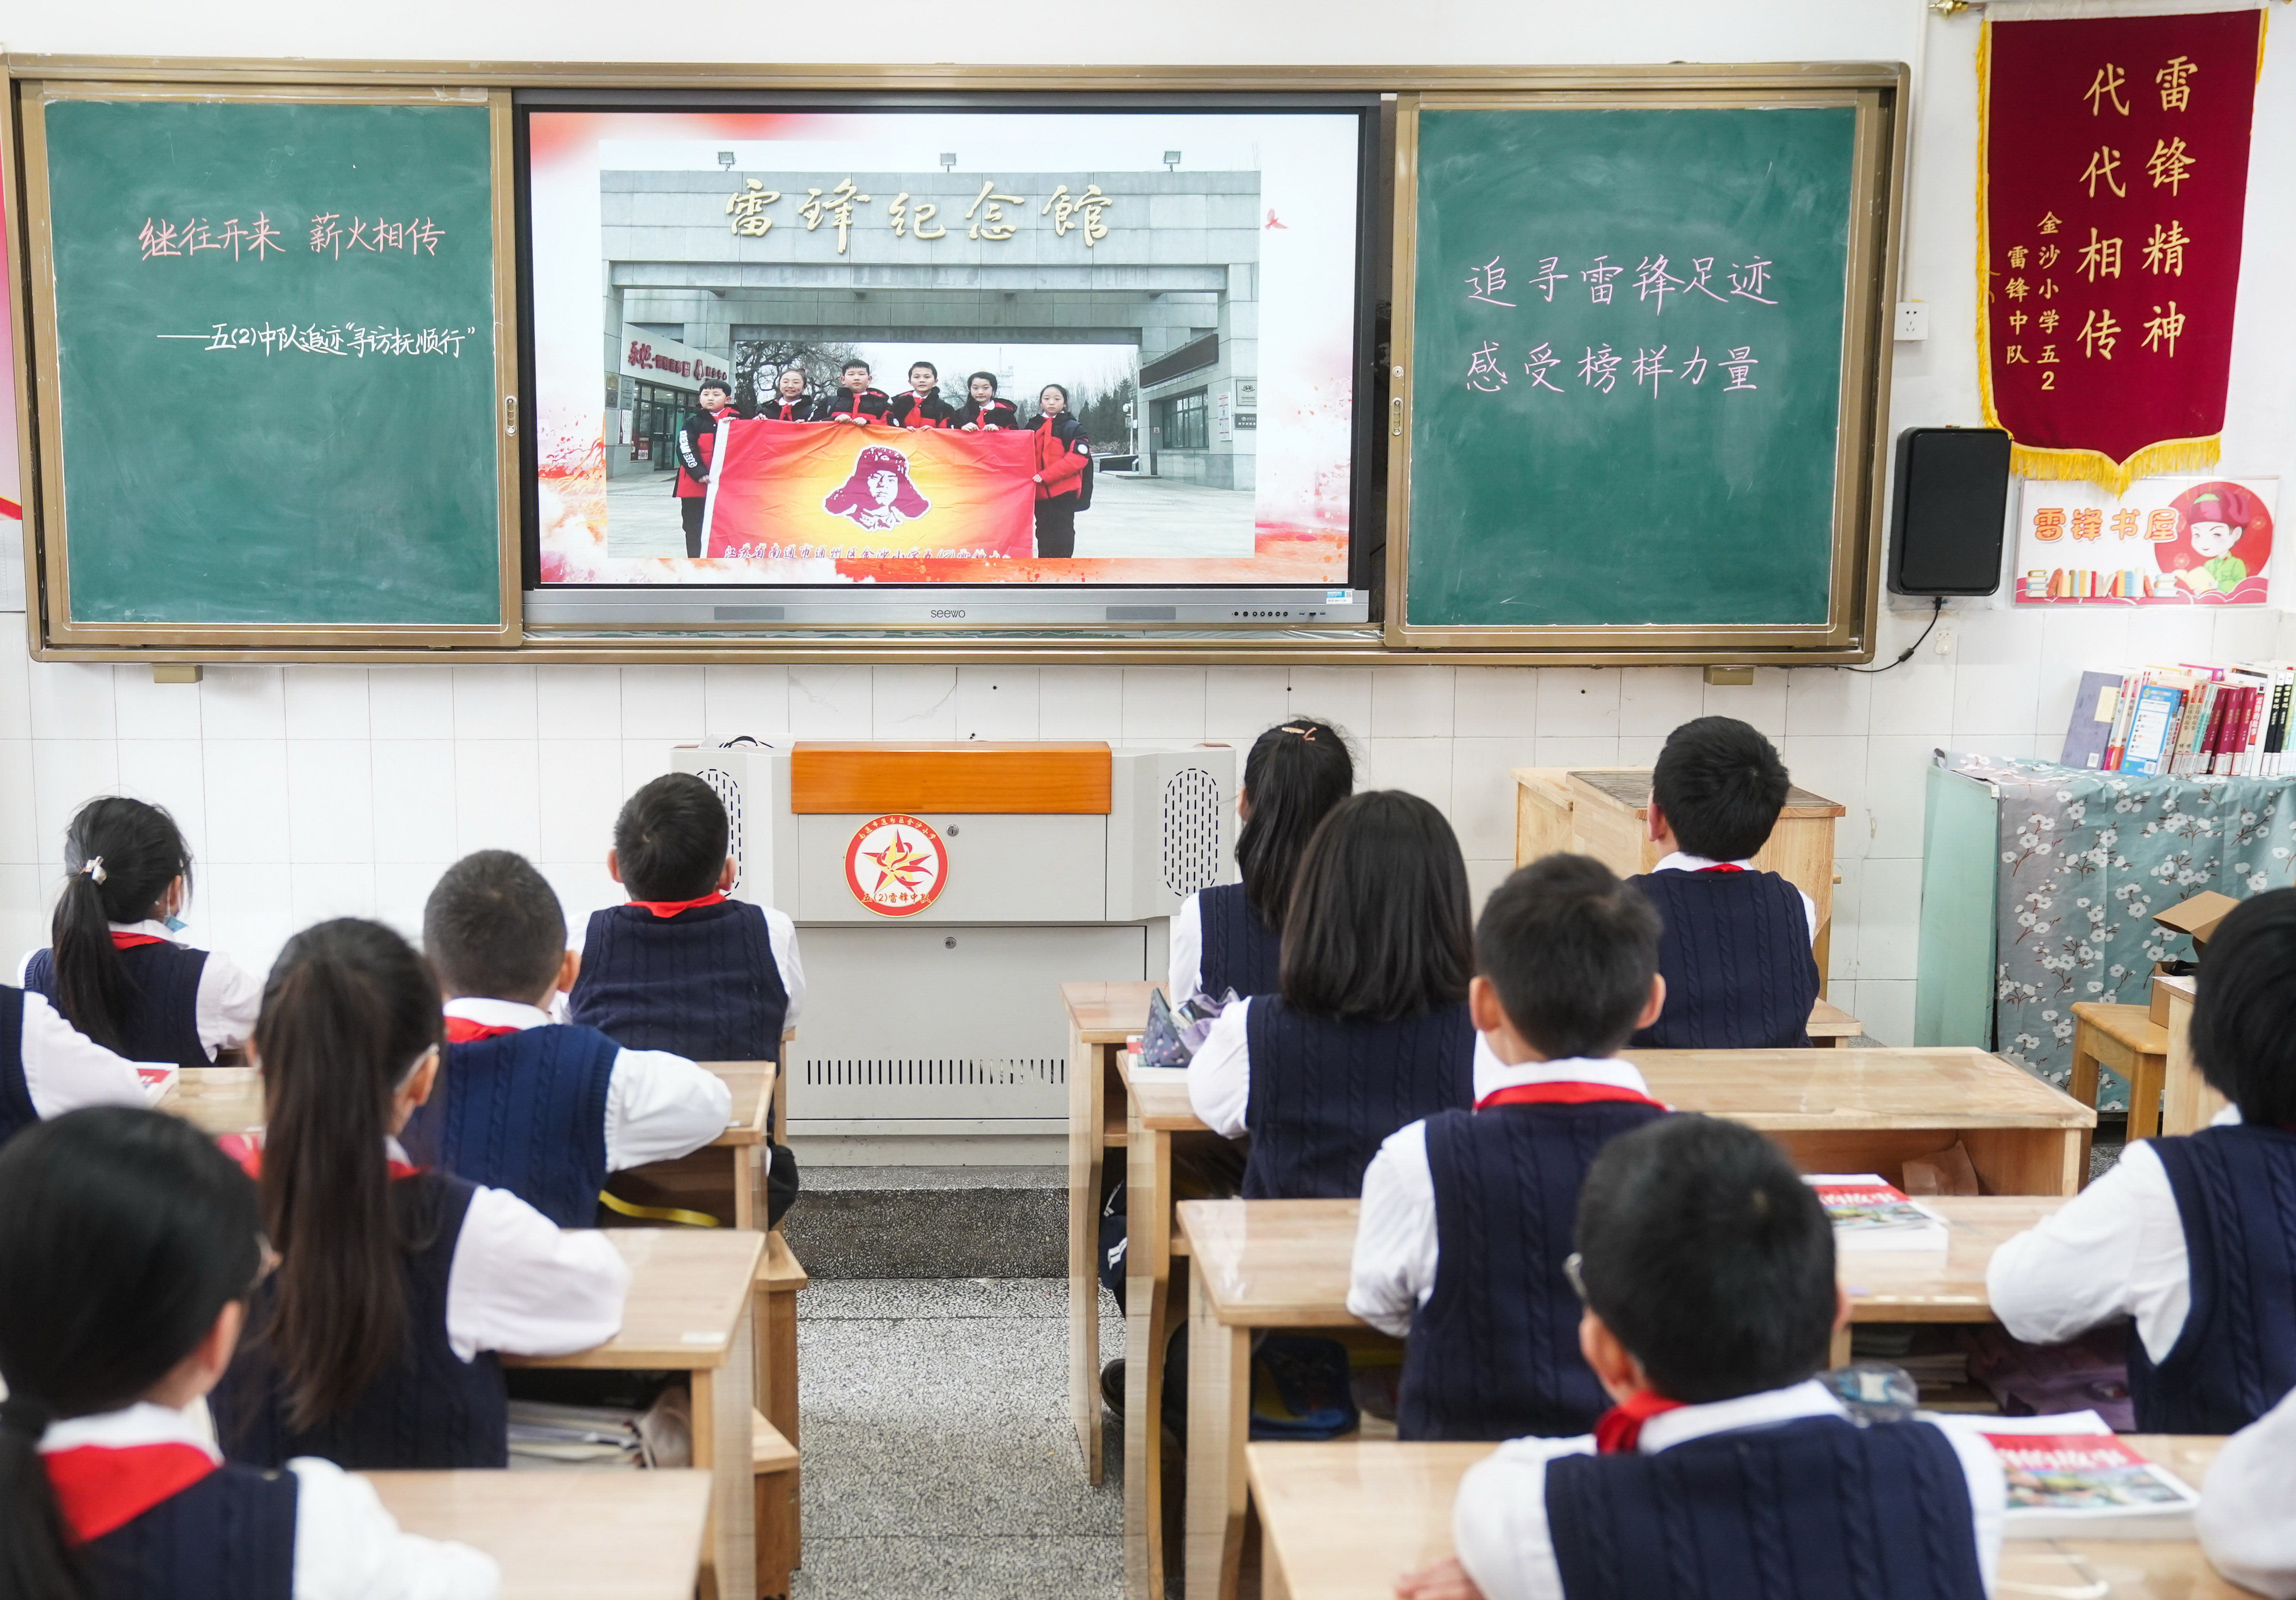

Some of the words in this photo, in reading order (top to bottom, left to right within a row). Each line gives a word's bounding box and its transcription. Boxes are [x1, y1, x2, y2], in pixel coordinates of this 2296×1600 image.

[138, 211, 286, 261] 继往开来
[310, 212, 446, 261] 薪火相传
[2076, 62, 2129, 360] 代代相传
[2141, 56, 2198, 358] 雷锋精神
[1464, 254, 1778, 316] 追寻雷锋足迹
[2005, 246, 2030, 364] 雷锋中队
[2036, 211, 2062, 390] 金沙小学五2
[1467, 341, 1759, 400] 感受榜样力量
[2034, 507, 2178, 544] 雷锋书屋
[931, 610, 965, 618] seewo
